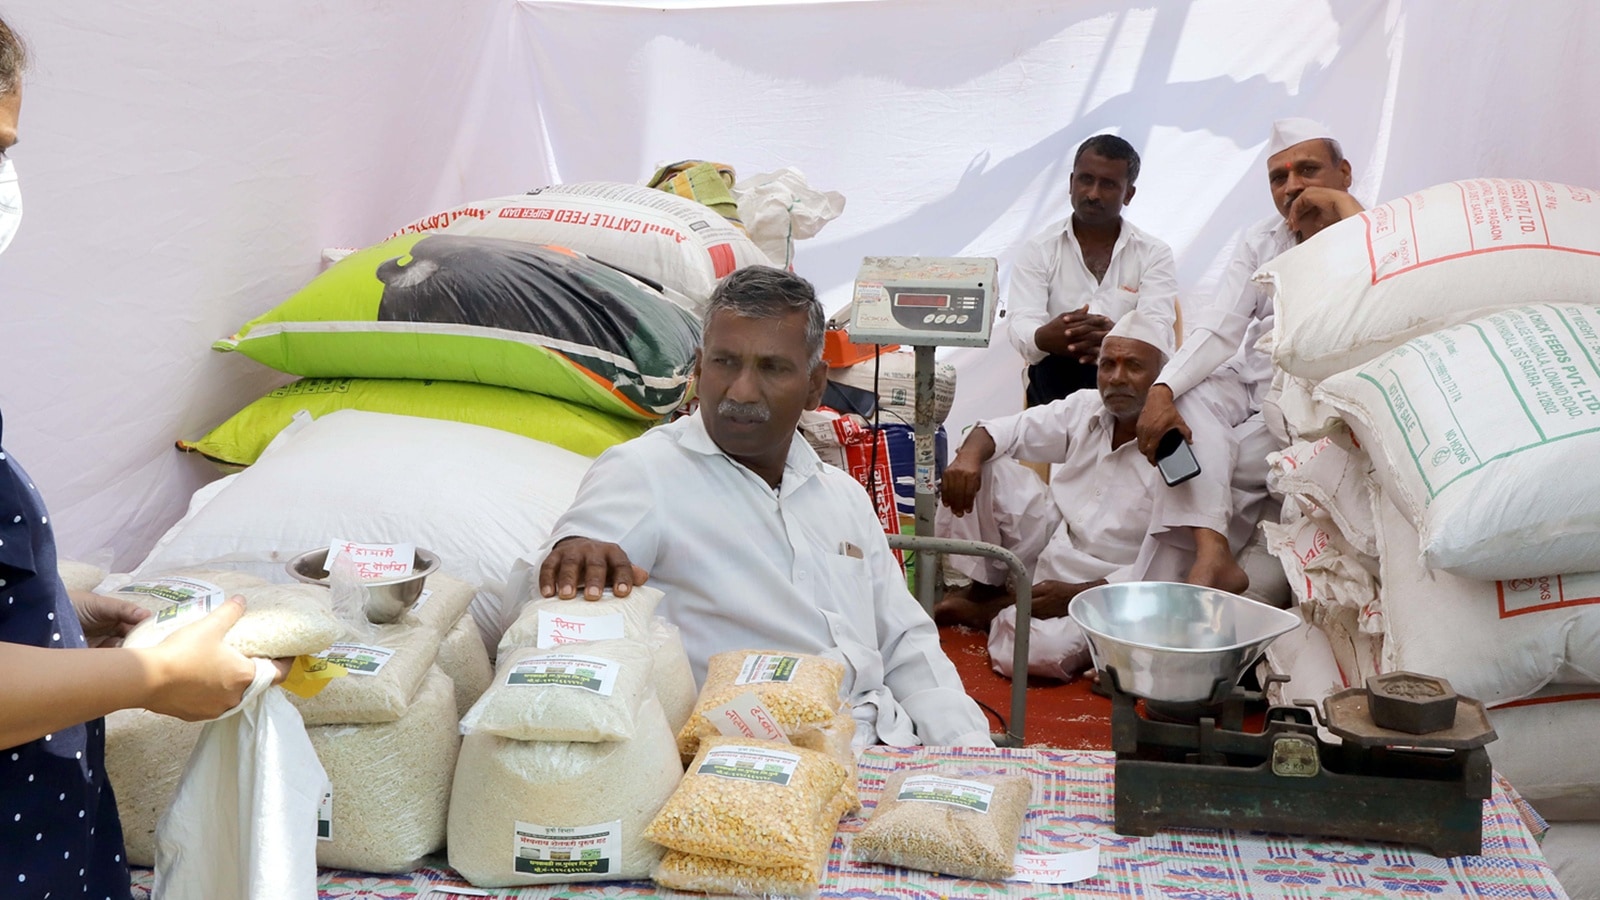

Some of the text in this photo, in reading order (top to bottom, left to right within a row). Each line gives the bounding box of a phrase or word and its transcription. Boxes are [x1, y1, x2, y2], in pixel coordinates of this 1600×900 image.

[500, 208, 689, 243] Amul CATTLE FEED SUPER DAN
[1471, 204, 1484, 225] SATARA
[1487, 208, 1502, 240] PRAGAON
[1518, 215, 1536, 235] LTD.
[1572, 316, 1598, 340] WEIGHT
[1519, 359, 1543, 388] SATARA
[1542, 333, 1572, 363] FEEDS
[1561, 365, 1586, 389] PVT.
[1577, 389, 1600, 415] LTD.
[1542, 367, 1569, 396] LONAND
[1559, 395, 1584, 420] ROAD,
[1393, 395, 1407, 412] FOR
[1400, 410, 1416, 432] SALE
[1445, 428, 1471, 465] NO HOOKS
[1538, 576, 1551, 600] OOKS
